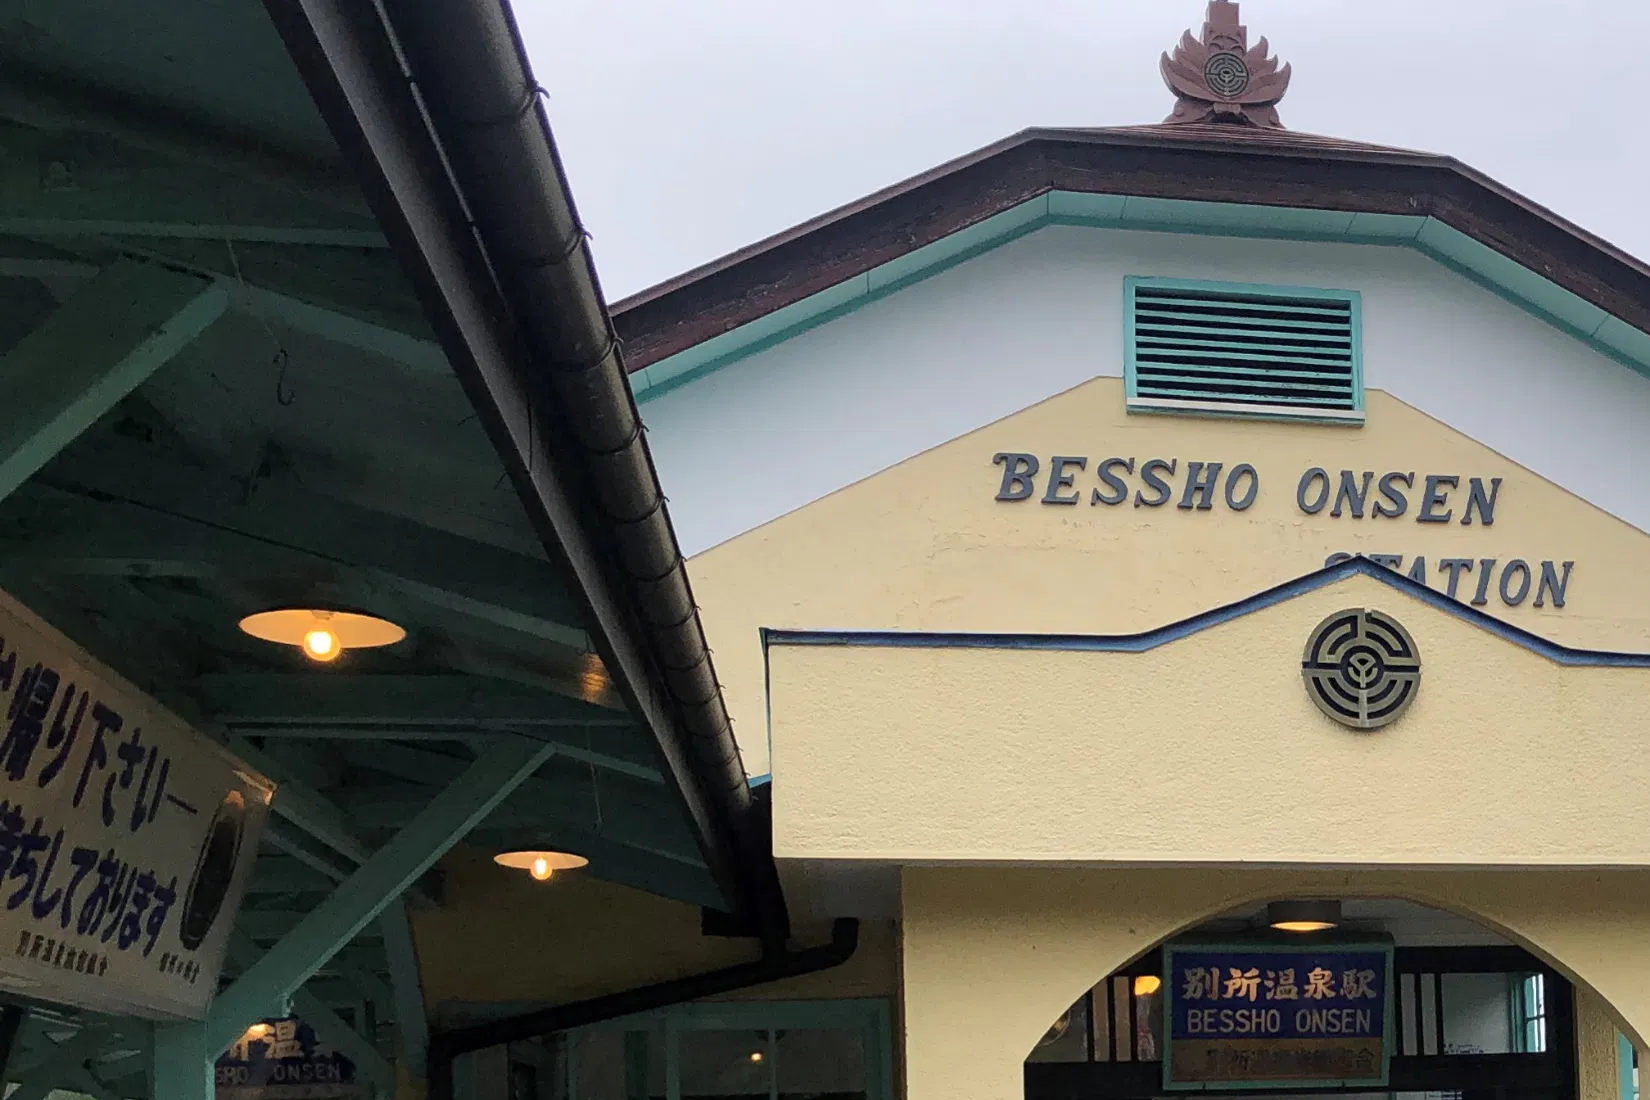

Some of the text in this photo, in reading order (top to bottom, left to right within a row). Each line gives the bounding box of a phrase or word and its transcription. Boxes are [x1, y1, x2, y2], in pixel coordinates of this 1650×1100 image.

[993, 453, 1503, 526] BESSHO ONSEN
[1181, 966, 1377, 1002] 別所温泉駅
[1187, 1008, 1371, 1034] BESSHO ONSEN
[273, 1062, 342, 1082] ONSEN
